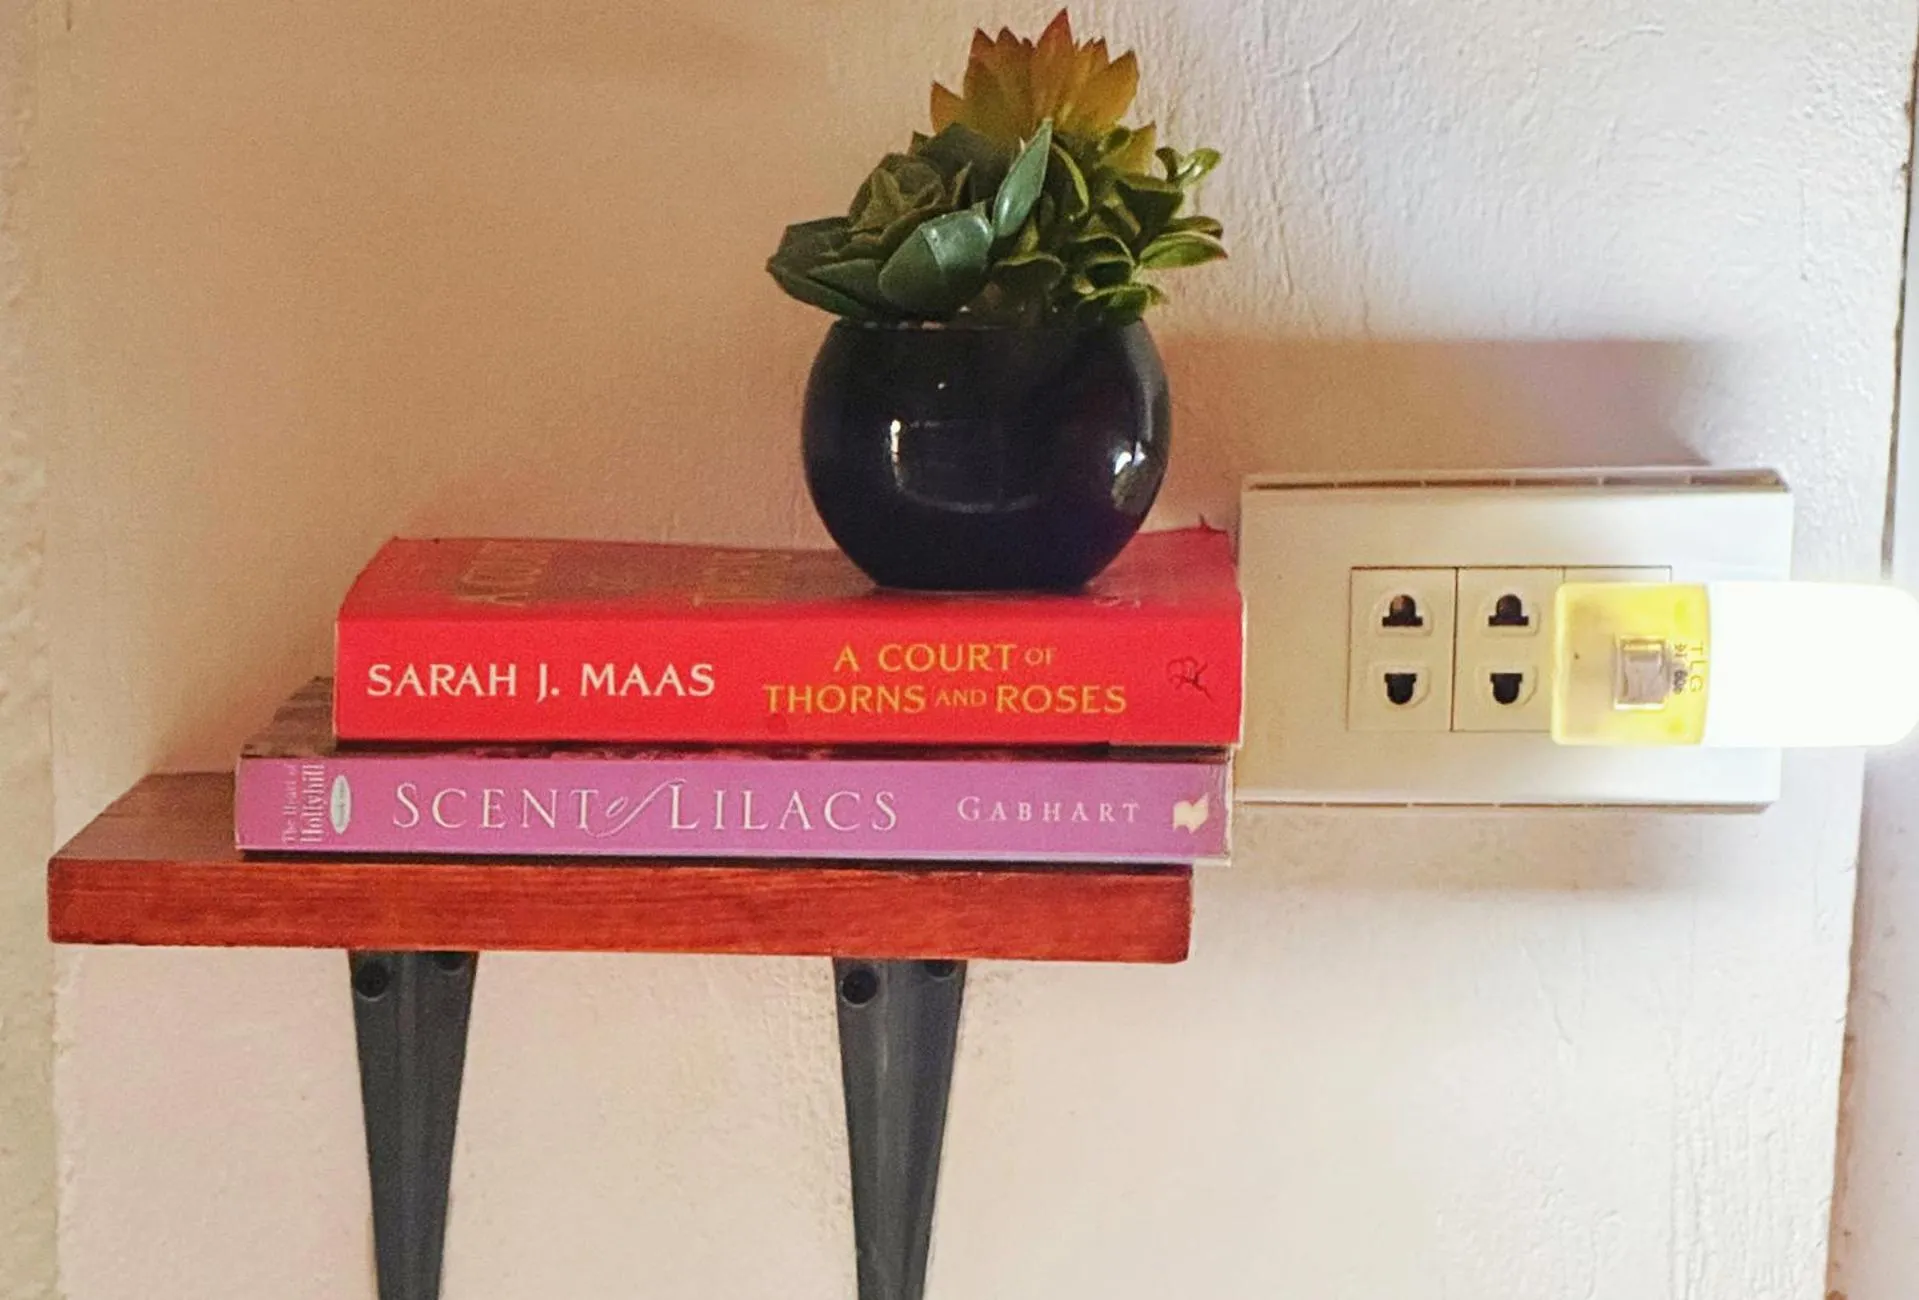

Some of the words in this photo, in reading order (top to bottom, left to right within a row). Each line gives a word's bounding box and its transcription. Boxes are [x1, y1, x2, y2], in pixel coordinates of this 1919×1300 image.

[833, 642, 860, 673] A
[878, 642, 1017, 673] COURT
[1023, 646, 1056, 667] OF
[367, 663, 517, 697] SARAH
[536, 664, 560, 703] J.
[580, 663, 716, 697] MAAS
[764, 684, 926, 714] THORNS
[934, 689, 988, 707] AND
[995, 684, 1127, 714] ROSES
[393, 782, 600, 831] SCENT
[668, 783, 898, 833] LILACS
[957, 796, 1140, 823] GABHART
